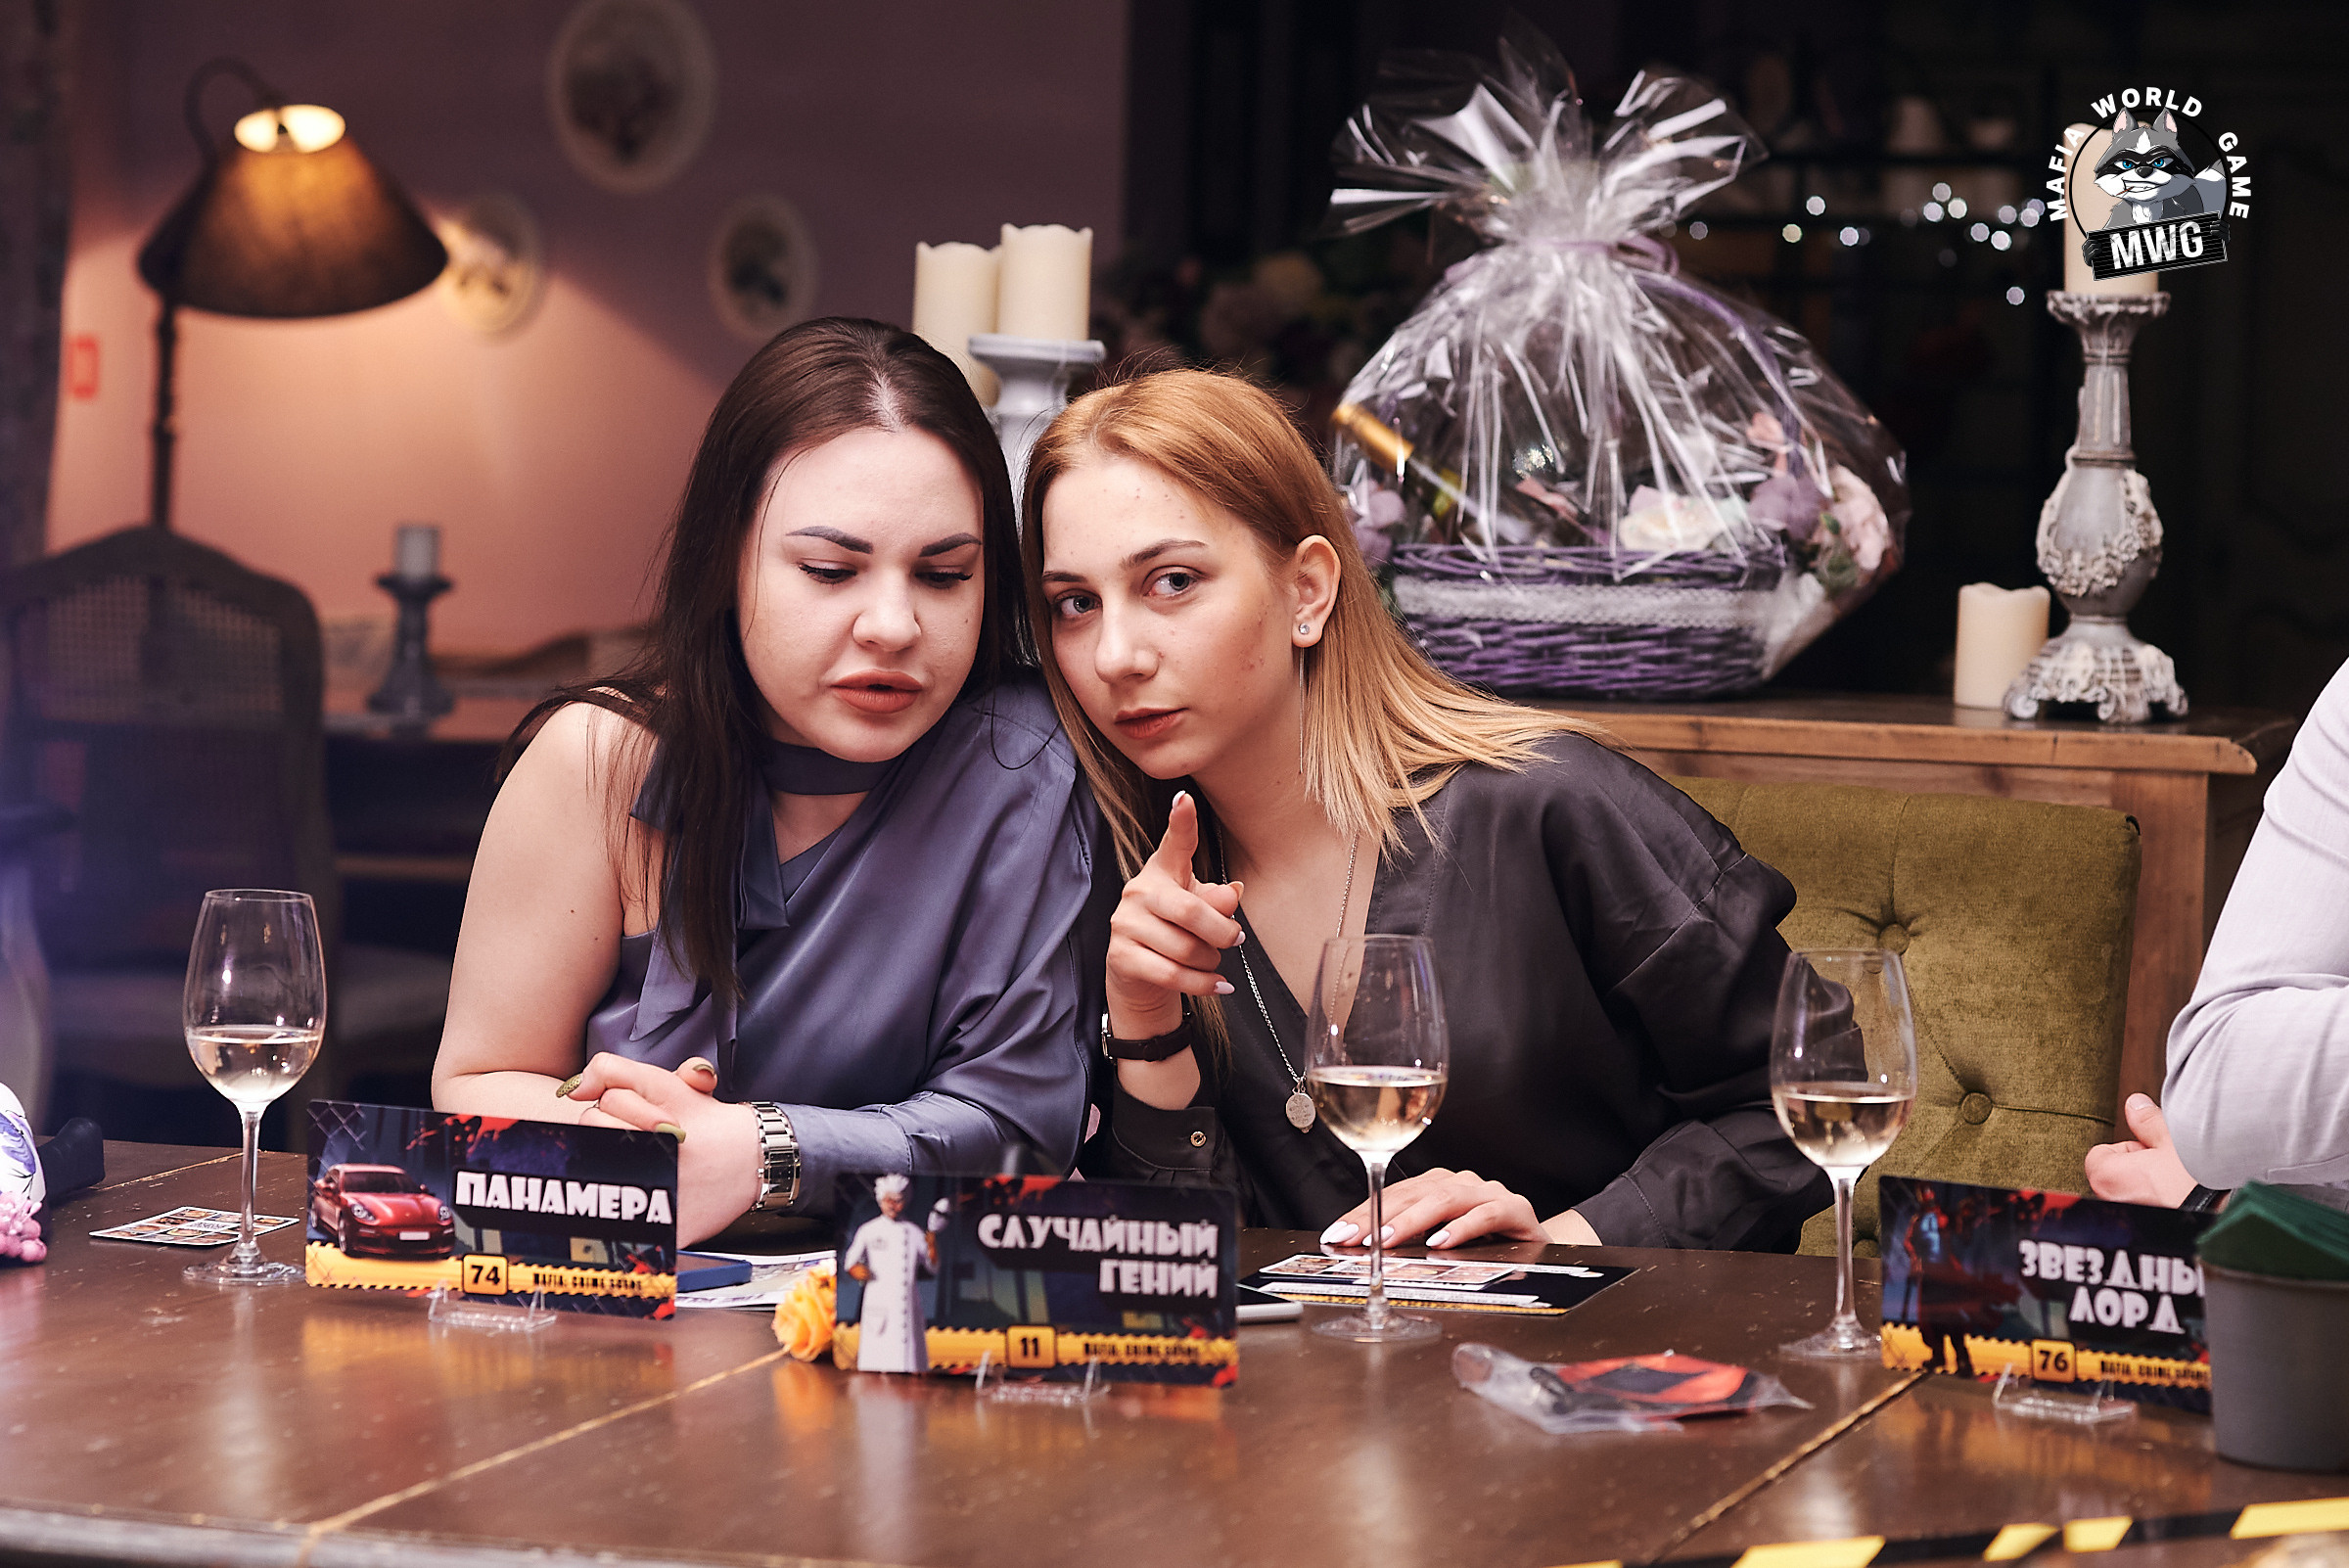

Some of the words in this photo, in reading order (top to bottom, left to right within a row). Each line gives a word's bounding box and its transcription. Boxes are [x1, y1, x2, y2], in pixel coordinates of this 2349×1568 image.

[454, 1170, 673, 1225] ПАНАМЕРА
[977, 1212, 1220, 1260] СЛУЧАЙНЫЙ
[470, 1265, 500, 1286] 74
[1099, 1259, 1220, 1299] ГЕНИЙ
[2018, 1239, 2206, 1298] ЗВЕЗДНЫ
[2069, 1285, 2186, 1334] ЛОРД
[1019, 1337, 1039, 1358] 11
[2038, 1350, 2068, 1372] 76
